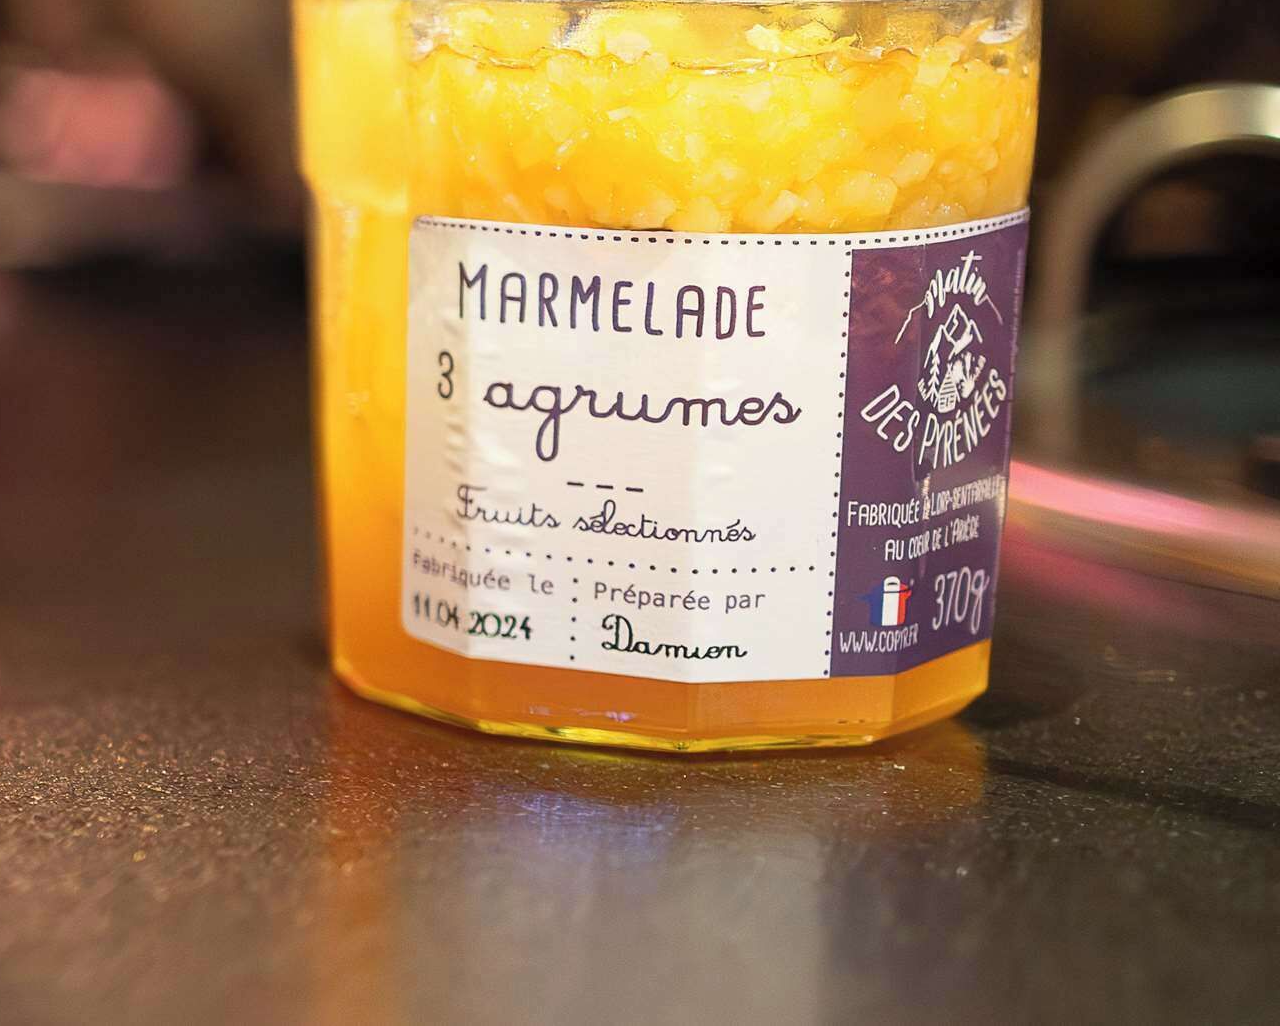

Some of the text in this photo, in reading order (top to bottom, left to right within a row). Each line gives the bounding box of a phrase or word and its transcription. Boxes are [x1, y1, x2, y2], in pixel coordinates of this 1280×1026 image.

[458, 260, 767, 340] MARMELADE
[926, 250, 987, 318] Matin
[436, 351, 802, 462] 3 agrumes
[860, 368, 1007, 469] DES PYRÉNÉES
[455, 484, 757, 543] Fruits sélectionnés
[847, 498, 920, 529] FABRIQUÉE
[411, 553, 554, 595] Fabriquée le
[884, 538, 904, 561] AU
[594, 581, 766, 614] Préparée par
[932, 566, 990, 635] 370g
